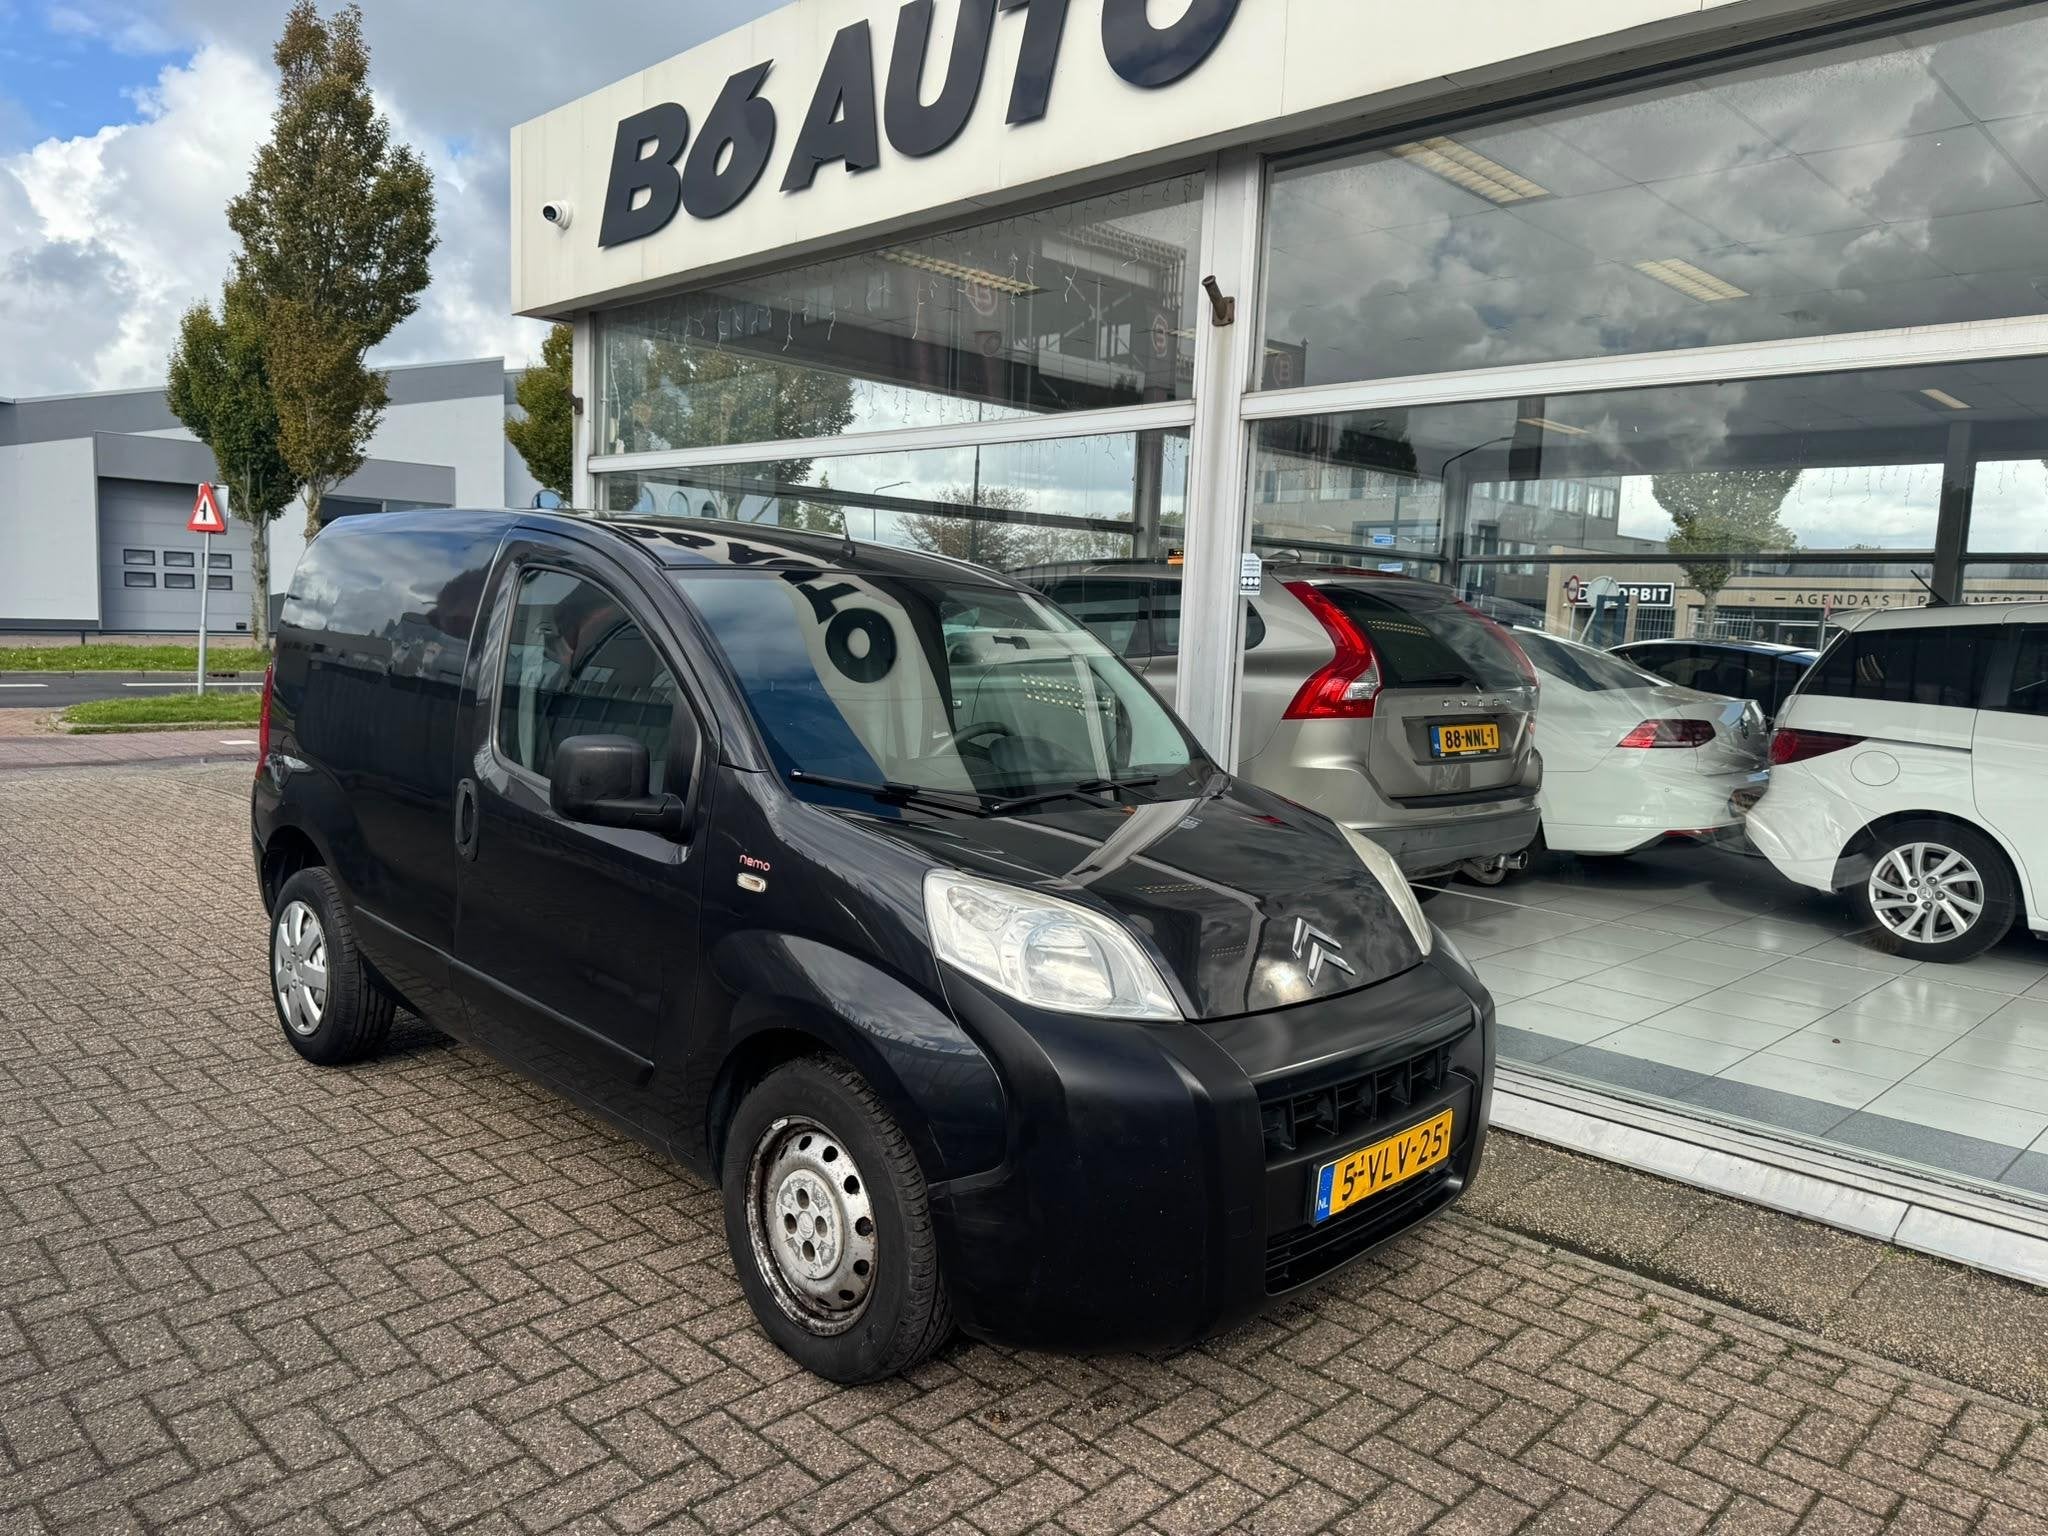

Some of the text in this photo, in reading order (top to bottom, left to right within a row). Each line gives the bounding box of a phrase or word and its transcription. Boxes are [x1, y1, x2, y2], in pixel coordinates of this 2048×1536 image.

[599, 59, 776, 248] B6
[1795, 593, 1890, 607] AGENDA'S
[1445, 728, 1495, 749] 88-NNL-1
[739, 854, 771, 871] nemo
[1341, 1122, 1443, 1201] 5-VLV-25
[1317, 1197, 1329, 1210] NL
